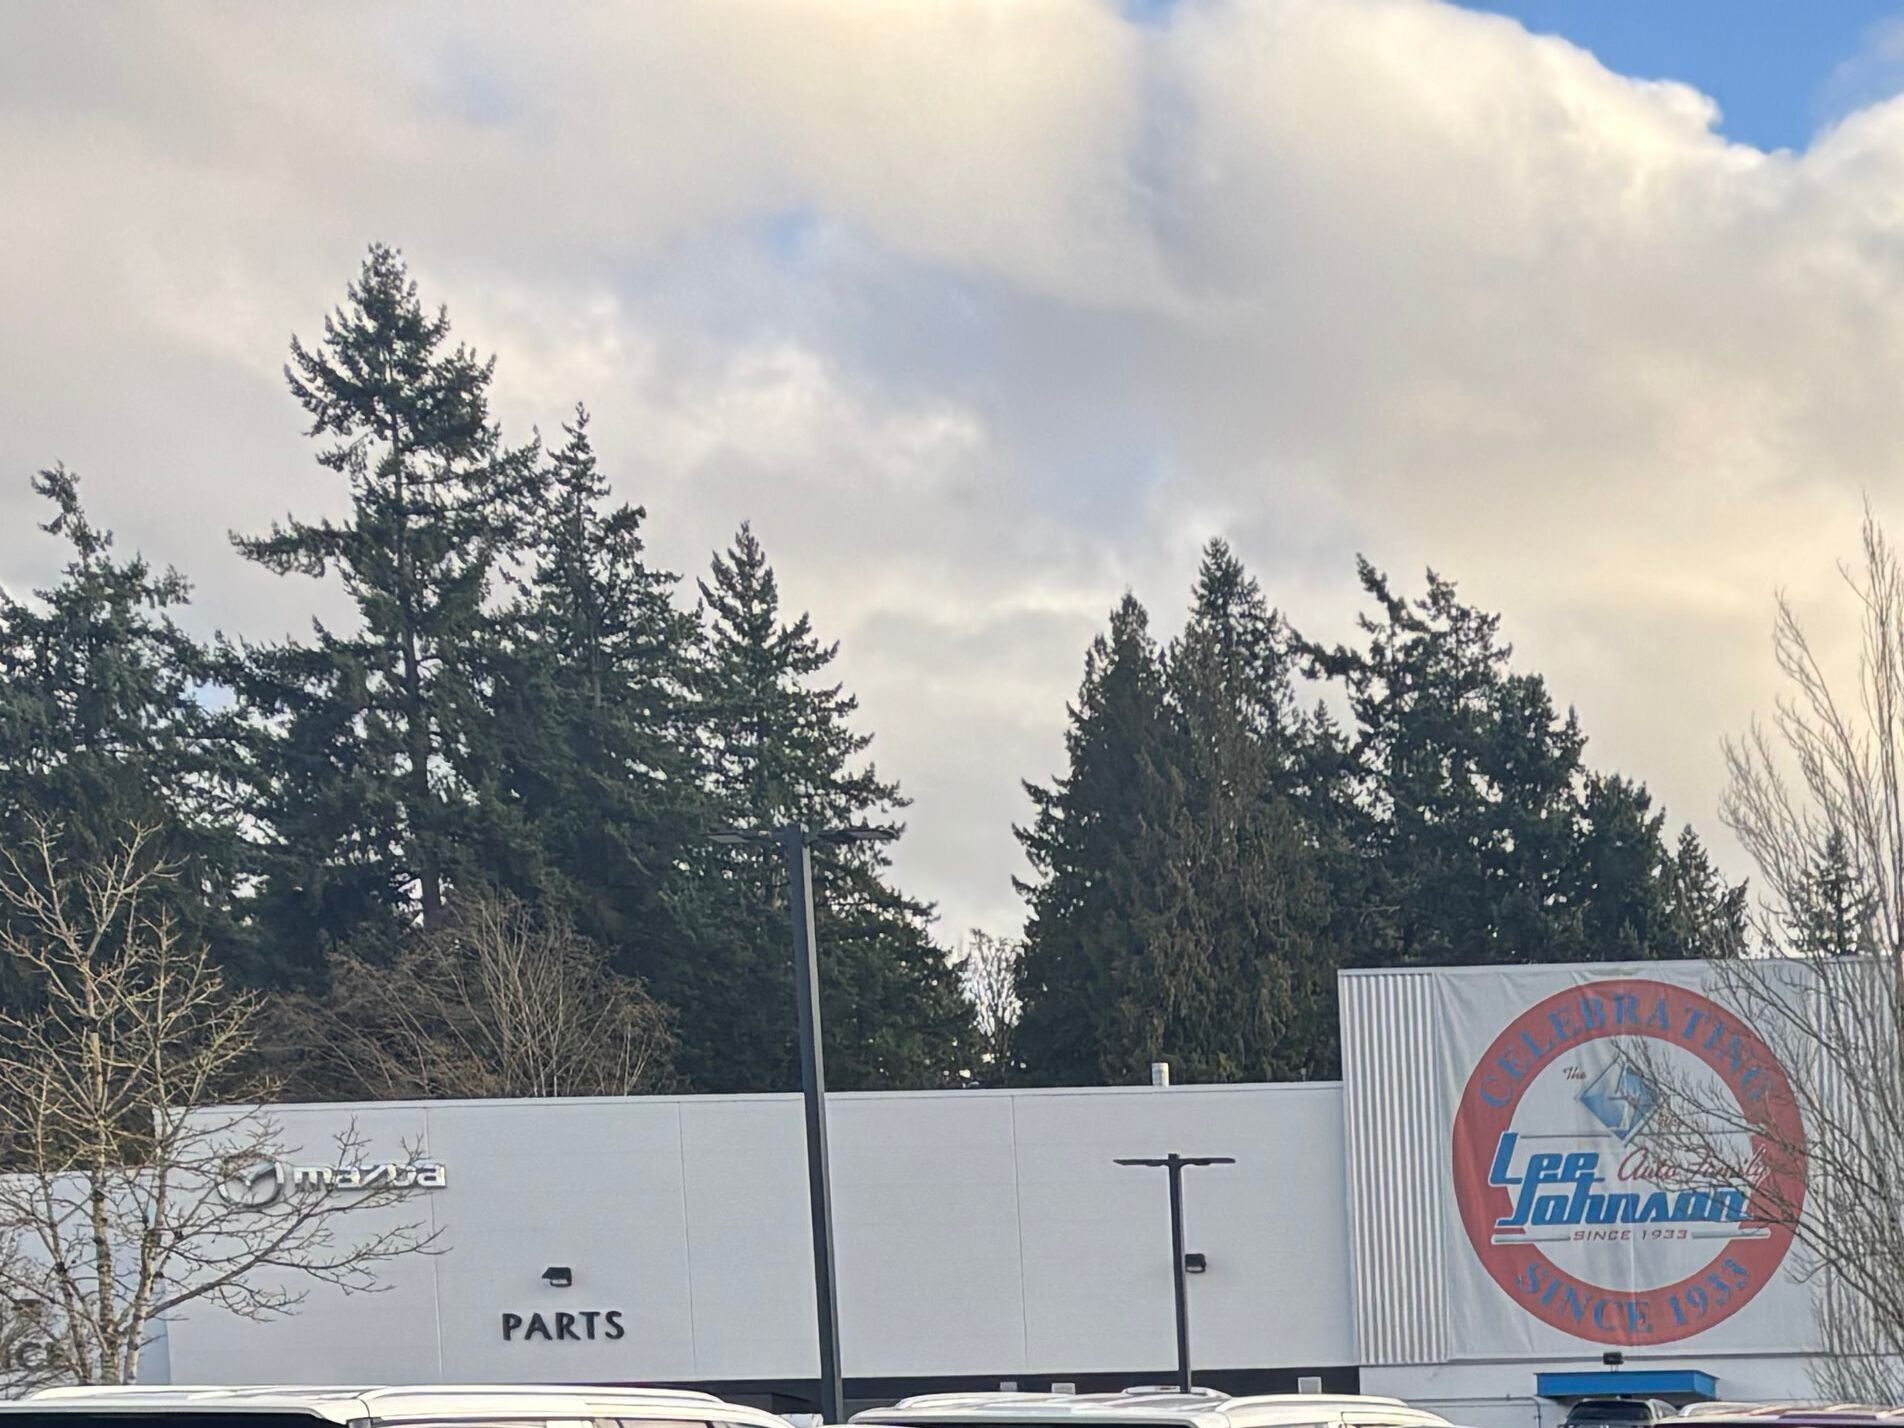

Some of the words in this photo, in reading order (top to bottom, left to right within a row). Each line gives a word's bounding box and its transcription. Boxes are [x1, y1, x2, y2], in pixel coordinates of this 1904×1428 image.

[1479, 992, 1773, 1109] CELEBRATING
[1563, 1066, 1587, 1081] The
[1489, 1130, 1604, 1187] Lee
[1495, 1166, 1752, 1228] Johnson
[1573, 1229, 1631, 1241] SINCE
[1641, 1228, 1688, 1240] 1933
[1514, 1261, 1652, 1335] SINCE
[1668, 1256, 1750, 1327] 1933
[502, 1310, 625, 1341] PARTS
